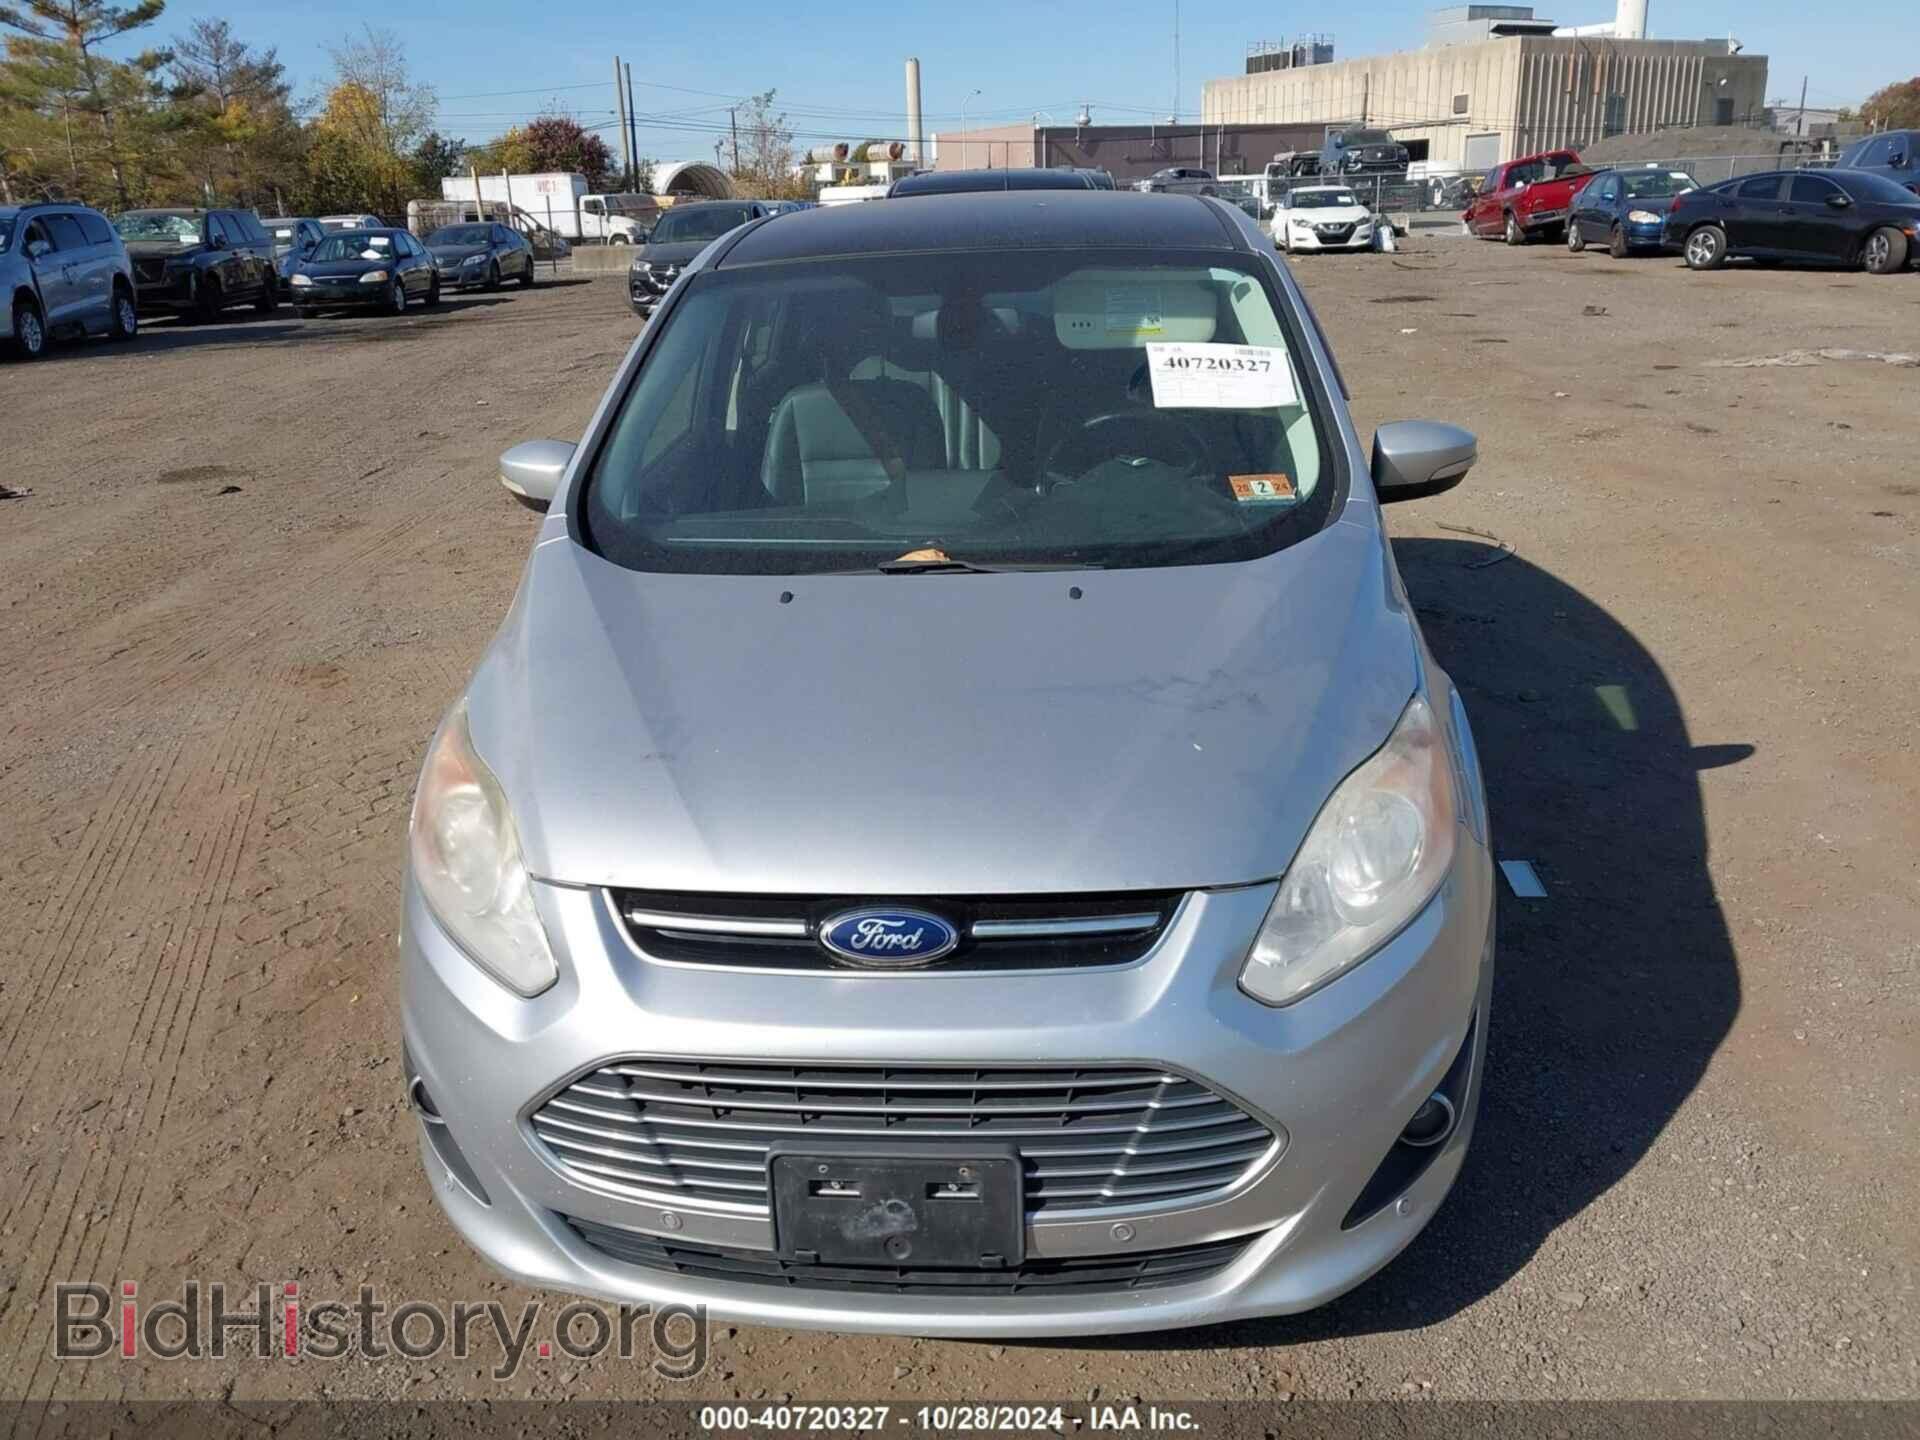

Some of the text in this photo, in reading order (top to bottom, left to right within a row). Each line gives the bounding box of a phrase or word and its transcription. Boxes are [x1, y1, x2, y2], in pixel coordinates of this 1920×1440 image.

[1163, 356, 1271, 373] 40720327
[1258, 482, 1267, 493] 2
[851, 918, 924, 950] Ford
